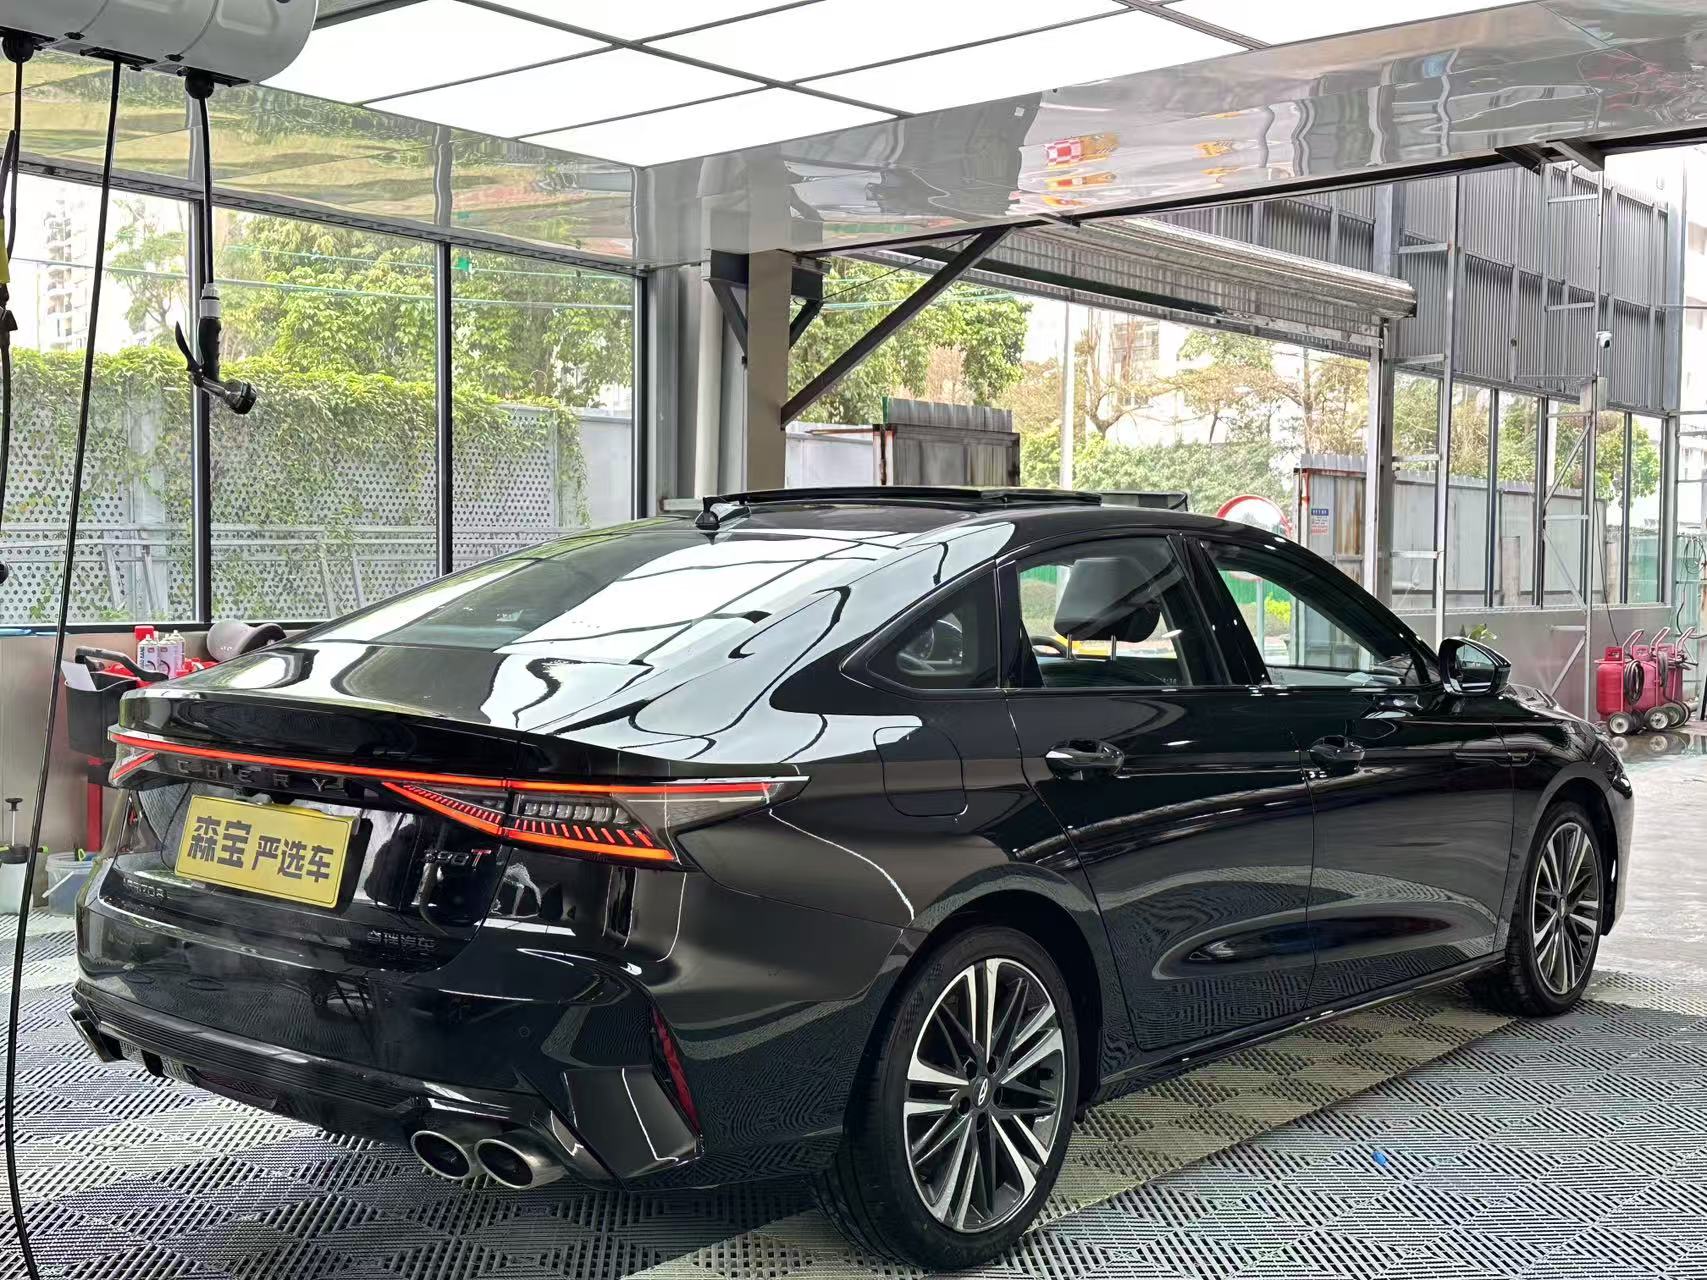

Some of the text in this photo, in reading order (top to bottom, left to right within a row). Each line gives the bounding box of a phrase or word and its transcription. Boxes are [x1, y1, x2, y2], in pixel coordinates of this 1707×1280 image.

[177, 759, 326, 793] CHERY
[251, 834, 334, 883] 严选车
